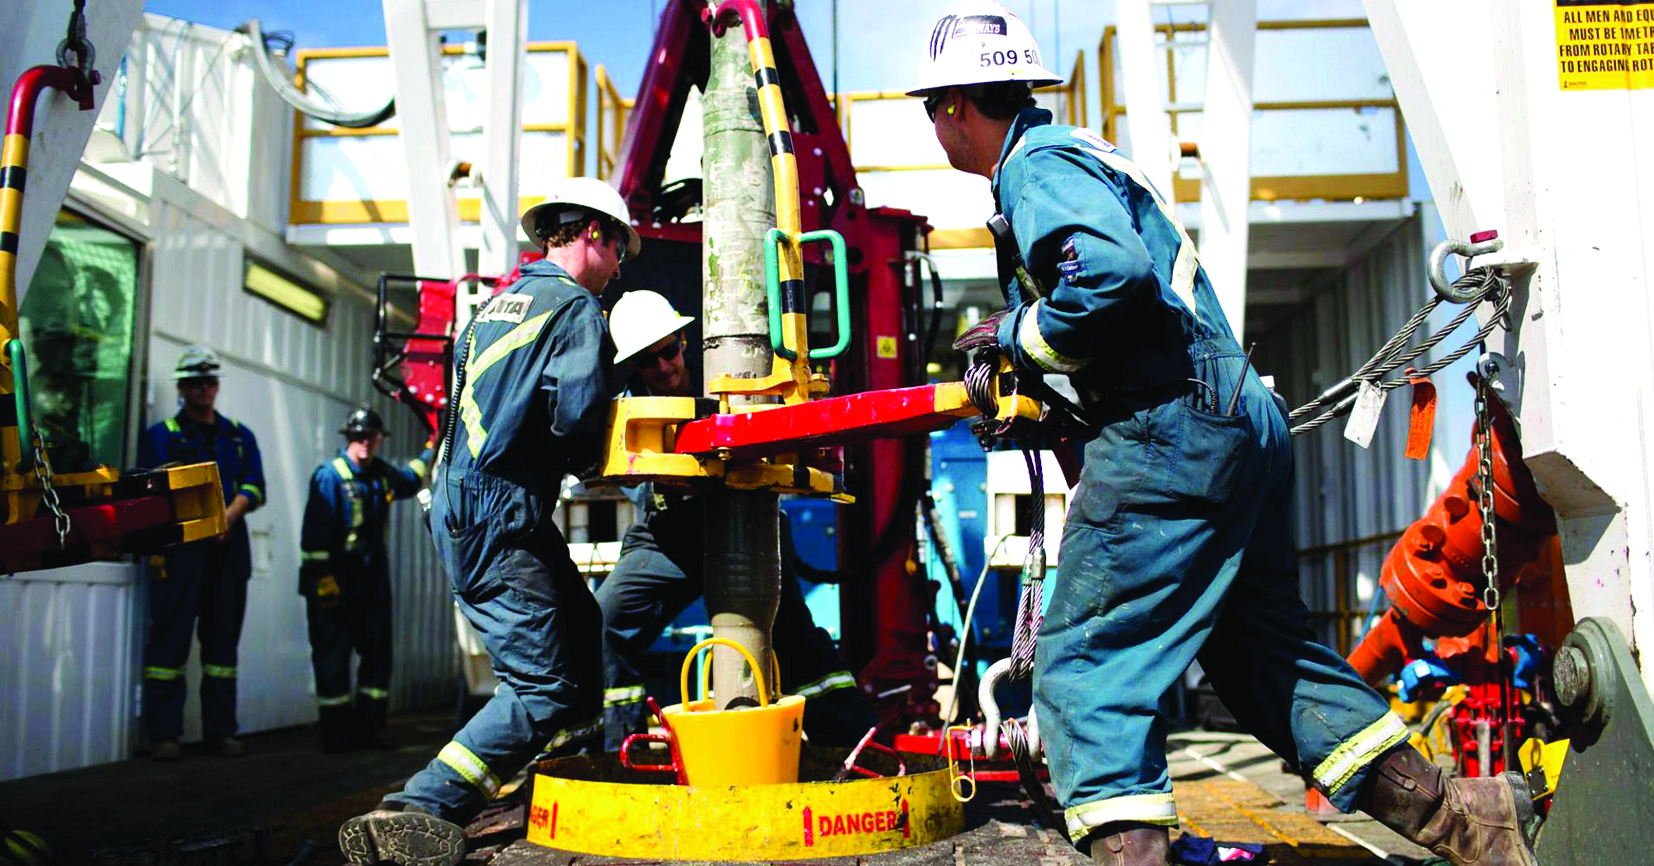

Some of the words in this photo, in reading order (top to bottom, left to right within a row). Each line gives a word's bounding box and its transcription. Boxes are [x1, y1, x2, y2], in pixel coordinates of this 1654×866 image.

[1564, 11, 1583, 23] ALL
[1585, 10, 1610, 23] MEN
[1569, 28, 1600, 40] MUST
[1604, 27, 1616, 40] BE
[1559, 44, 1591, 57] FROM
[1593, 43, 1631, 56] ROTARY
[980, 49, 1018, 67] 509
[1024, 49, 1041, 66] 50
[1560, 61, 1574, 73] TO
[1632, 58, 1654, 72] ROT
[529, 804, 549, 829] GER
[818, 810, 898, 837] DANGER
